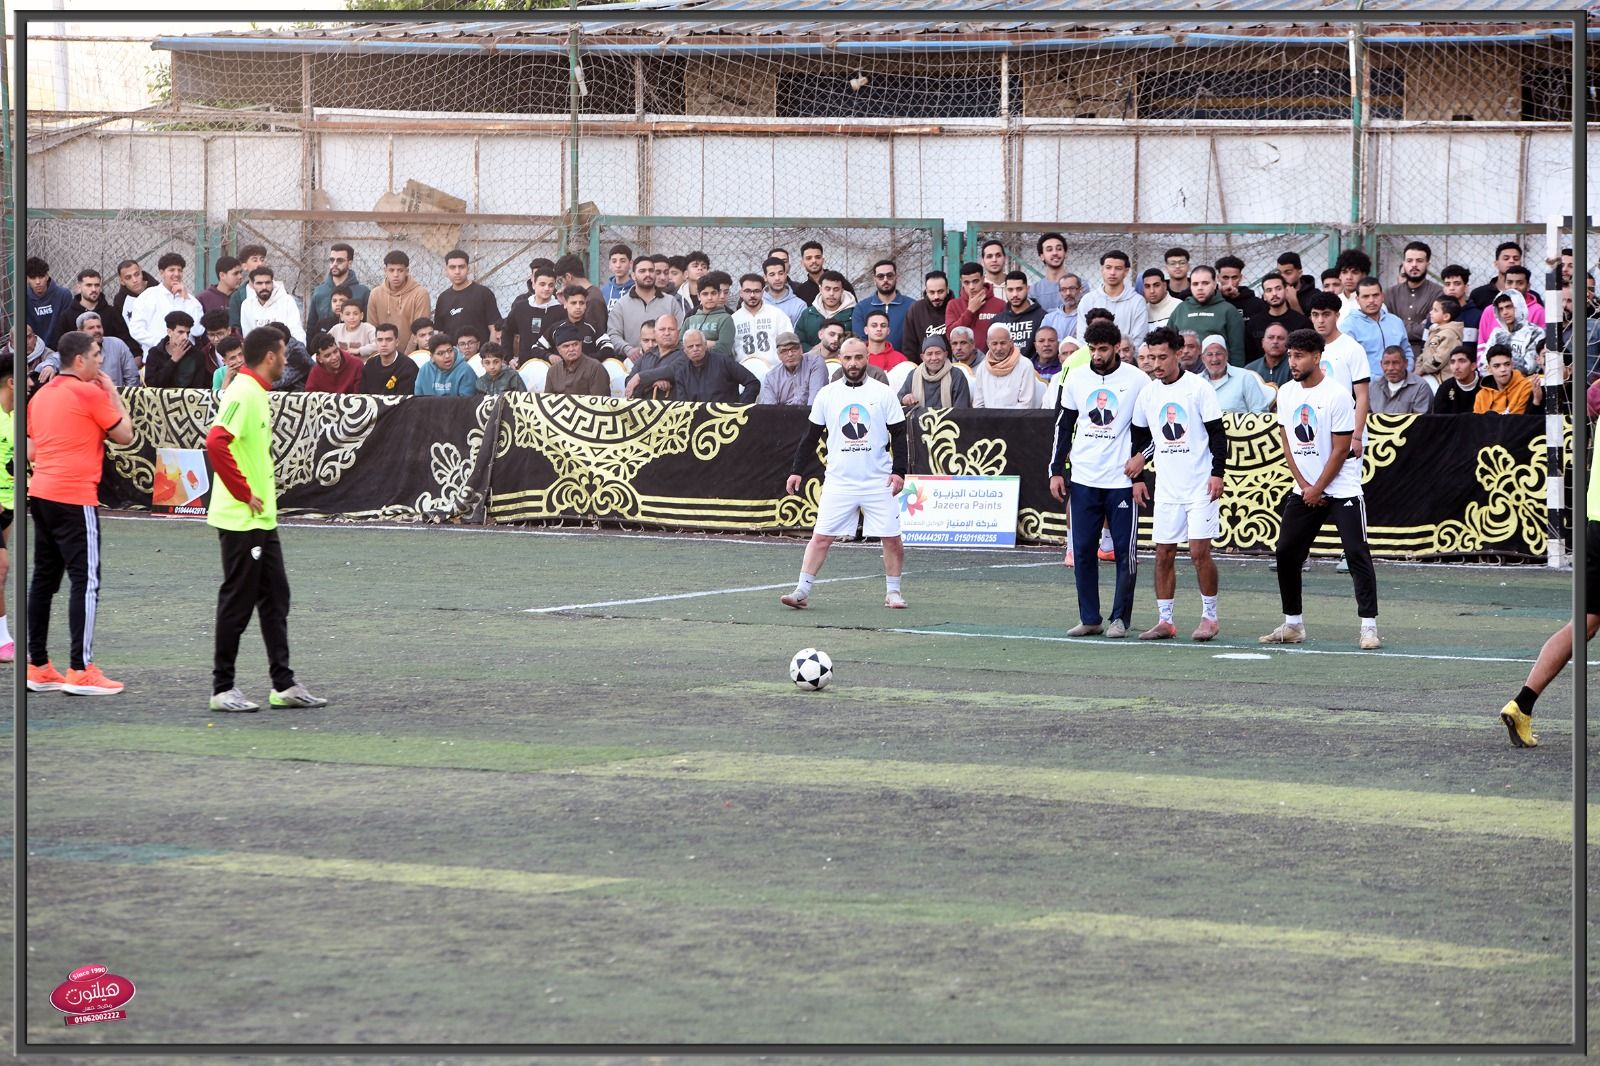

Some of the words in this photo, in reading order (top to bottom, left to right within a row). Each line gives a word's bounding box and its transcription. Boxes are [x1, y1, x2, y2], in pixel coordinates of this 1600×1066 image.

[34, 304, 53, 316] VANS
[1009, 330, 1032, 340] BBIT
[933, 488, 966, 499] الجزيرة
[968, 489, 1003, 498] دهانات
[933, 500, 970, 510] Jazeera
[972, 500, 1002, 510] Paints
[976, 518, 998, 530] شركة
[906, 534, 949, 542] 01044442978
